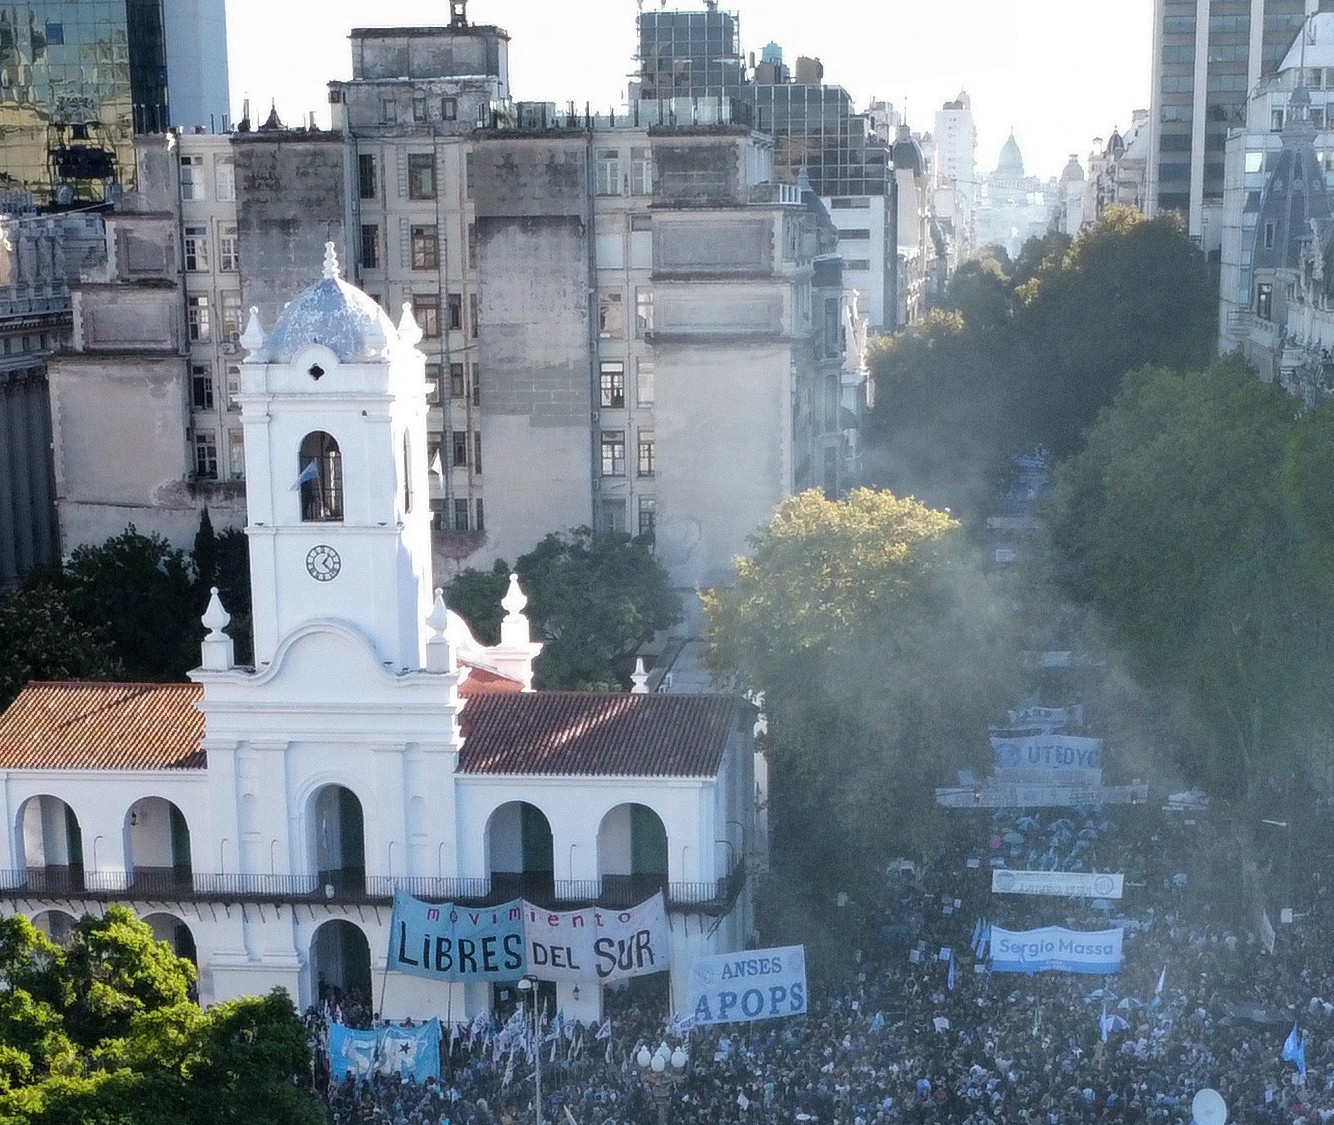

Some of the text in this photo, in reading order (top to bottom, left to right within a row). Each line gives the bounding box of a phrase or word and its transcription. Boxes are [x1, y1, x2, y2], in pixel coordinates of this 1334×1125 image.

[426, 906, 633, 929] movimiento
[533, 941, 581, 971] DEL
[593, 929, 656, 978] SUR
[999, 937, 1114, 957] Sergio Massa
[721, 957, 783, 980] ANSES
[694, 982, 806, 1021] APOPS
